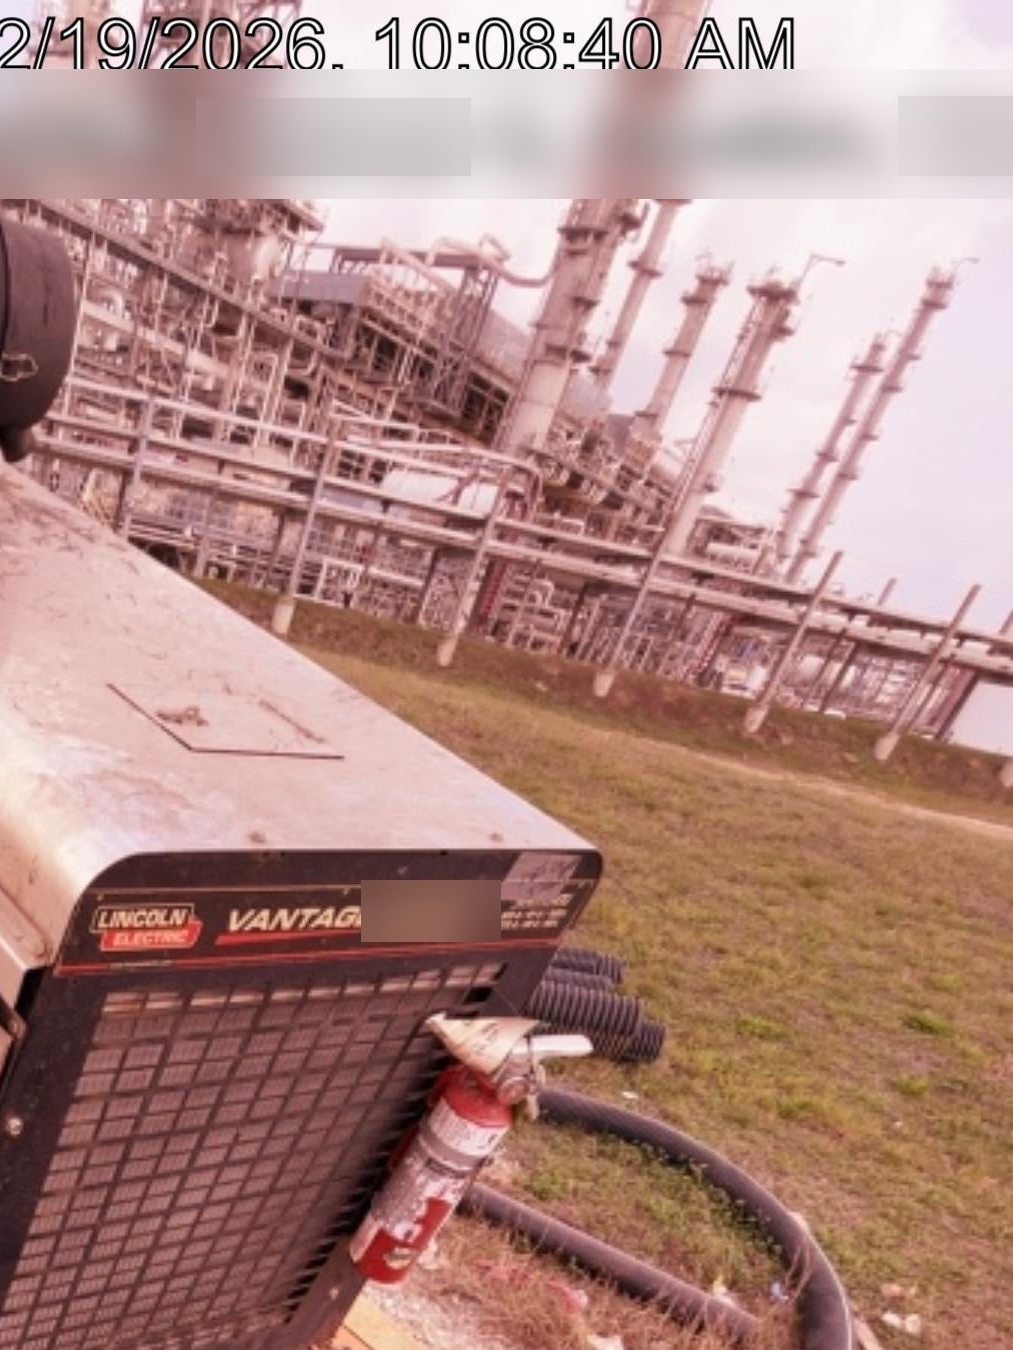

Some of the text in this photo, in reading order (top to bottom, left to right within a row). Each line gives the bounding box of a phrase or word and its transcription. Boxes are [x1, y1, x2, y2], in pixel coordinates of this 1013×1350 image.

[97, 905, 361, 932] LINCOLN VANTAG
[112, 928, 188, 948] ELECTRIC
